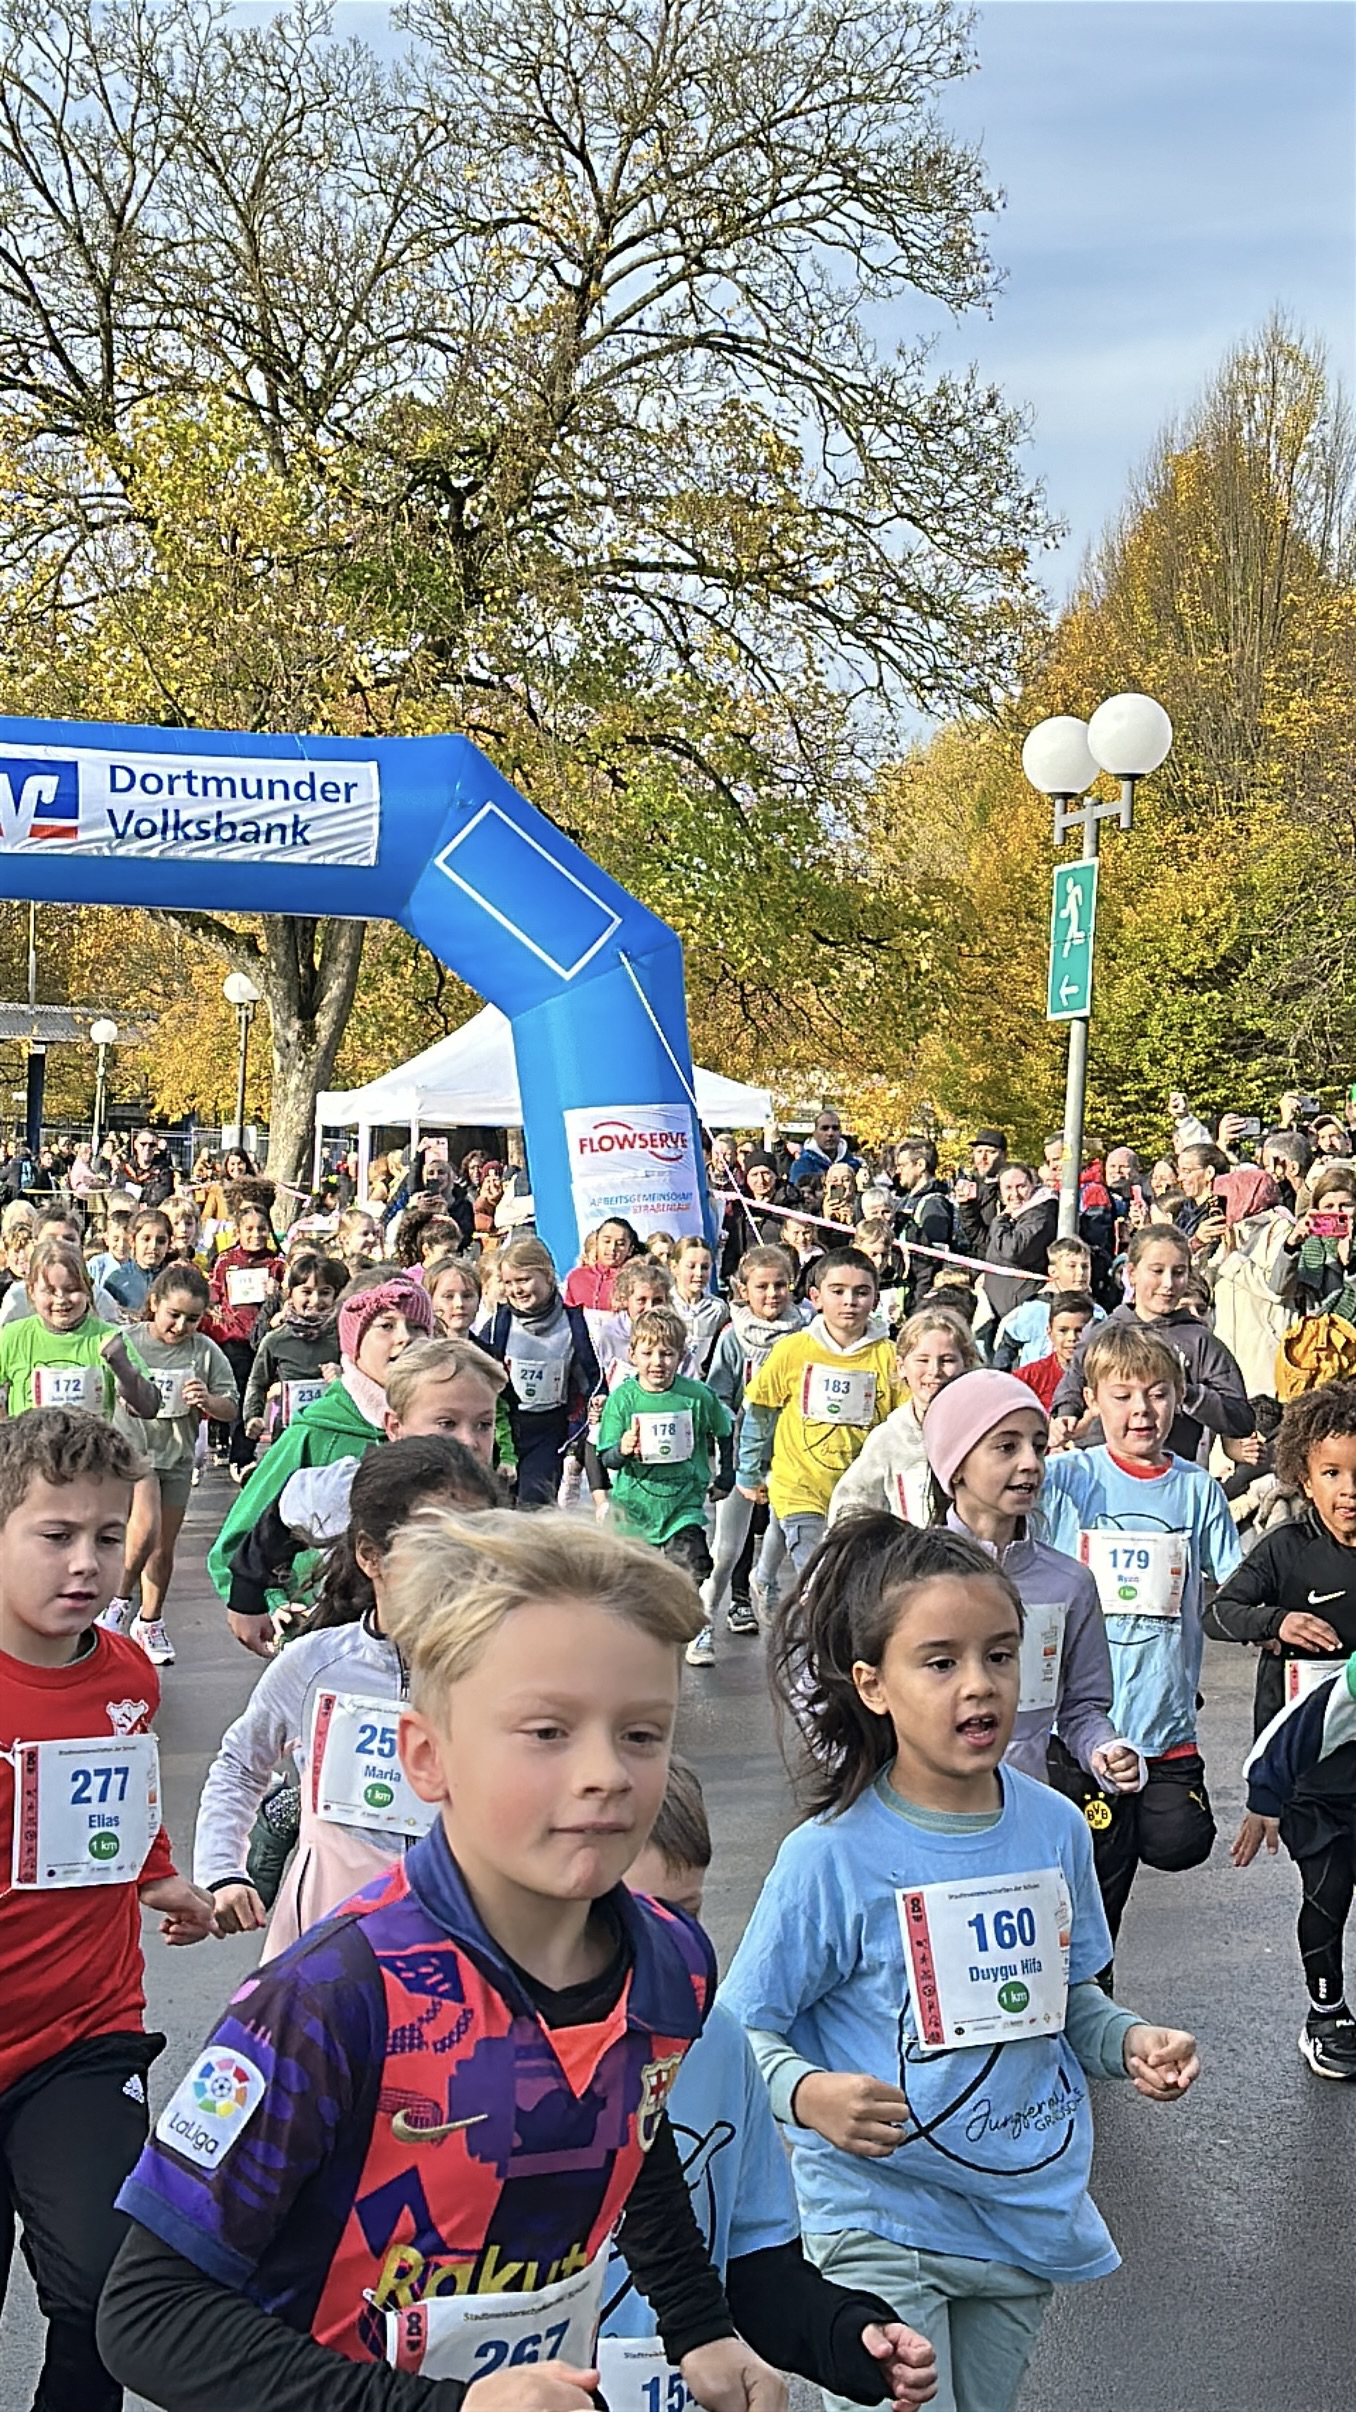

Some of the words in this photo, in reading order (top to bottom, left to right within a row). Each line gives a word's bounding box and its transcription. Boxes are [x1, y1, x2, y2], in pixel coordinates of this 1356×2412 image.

[109, 764, 357, 803] Dortmunder
[106, 808, 312, 847] Volksbank
[578, 1131, 688, 1155] FLOWSERVE
[54, 1379, 81, 1392] 172
[520, 1369, 543, 1381] 274
[823, 1378, 850, 1395] 183
[651, 1423, 676, 1436] 178
[1109, 1548, 1150, 1570] 179
[355, 1723, 398, 1759] 25
[364, 1765, 402, 1783] Maria
[71, 1766, 129, 1805] 277
[366, 1788, 372, 1799] 1
[374, 1789, 391, 1801] km
[88, 1813, 120, 1829] Elias
[1086, 1802, 1108, 1821] BVB
[90, 1842, 97, 1851] 1
[101, 1840, 118, 1850] km
[967, 1907, 1036, 1952] 160
[969, 1963, 1018, 1983] Duygu
[1000, 1991, 1008, 2004] 1
[1010, 1989, 1028, 2003] km
[168, 2111, 220, 2156] LaLiga
[374, 2242, 588, 2308] Rakut
[468, 2318, 571, 2384] 267
[641, 2372, 695, 2412] 15
